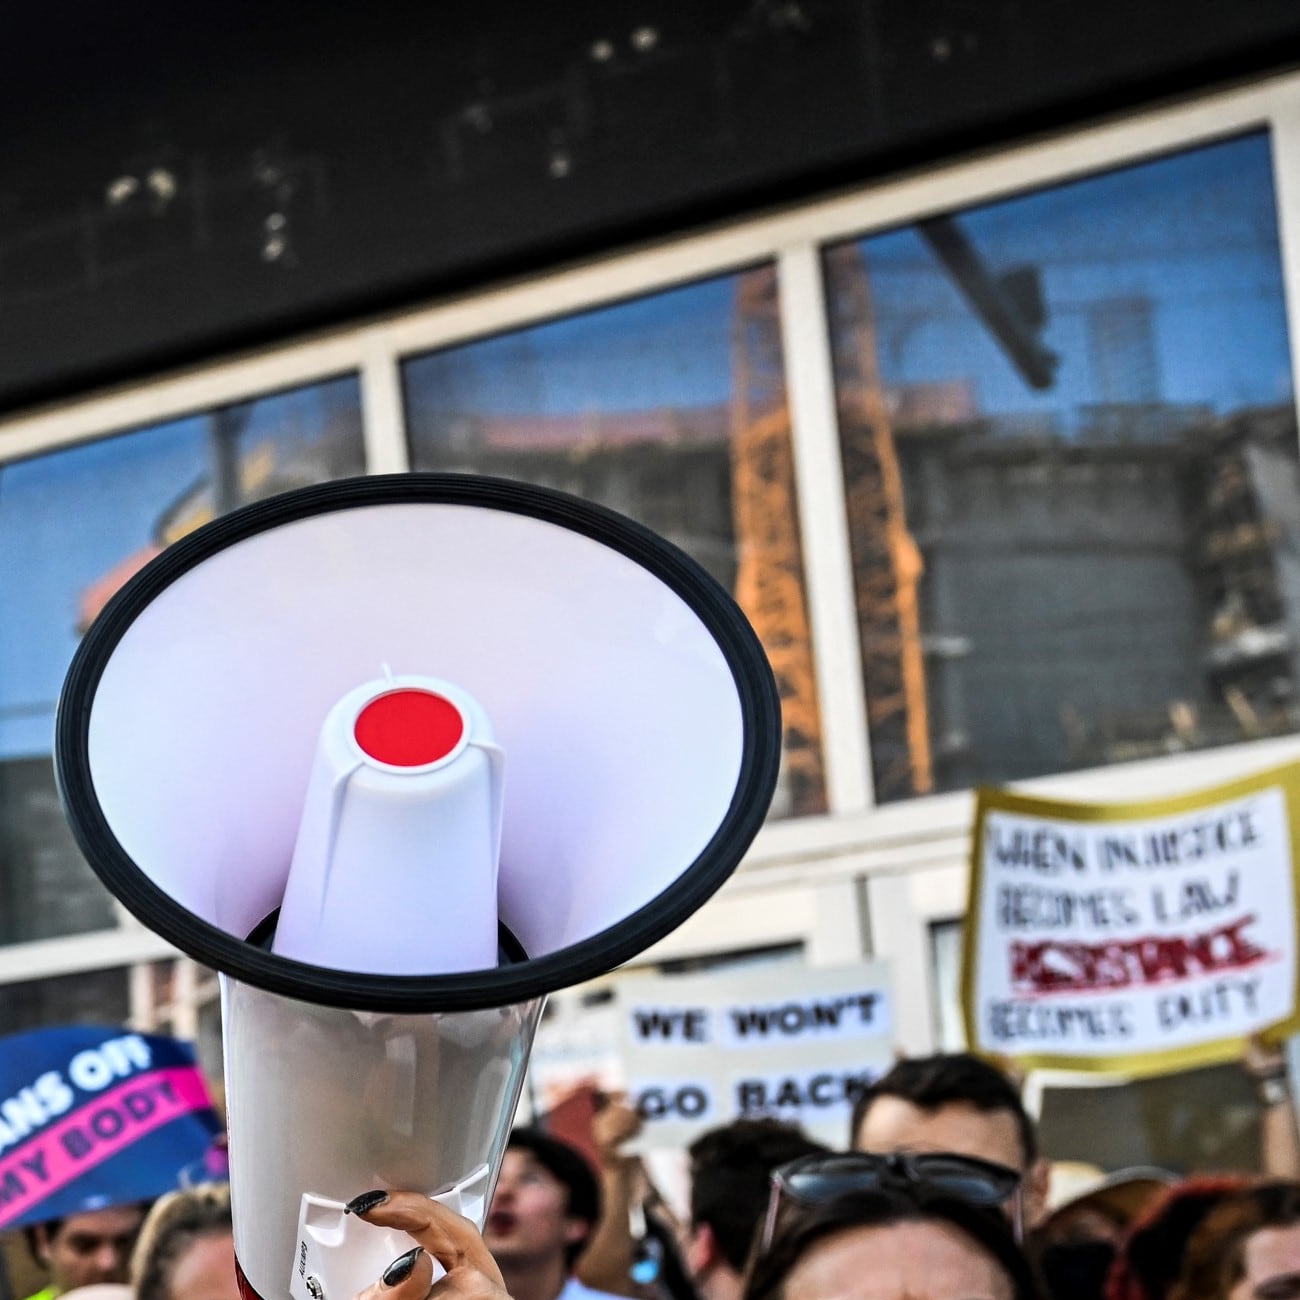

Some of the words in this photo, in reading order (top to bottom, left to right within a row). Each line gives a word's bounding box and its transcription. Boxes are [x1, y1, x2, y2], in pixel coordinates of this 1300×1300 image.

[997, 880, 1142, 931] BECOMES
[1150, 869, 1240, 923] LAW
[633, 1007, 707, 1043] WE
[731, 992, 882, 1036] WON'T
[988, 1001, 1135, 1040] BECOMES
[1157, 977, 1263, 1031] DUTY
[69, 1034, 152, 1091] OFF
[60, 1079, 177, 1160] BODY
[637, 1085, 707, 1119] GO
[736, 1069, 875, 1115] BACK
